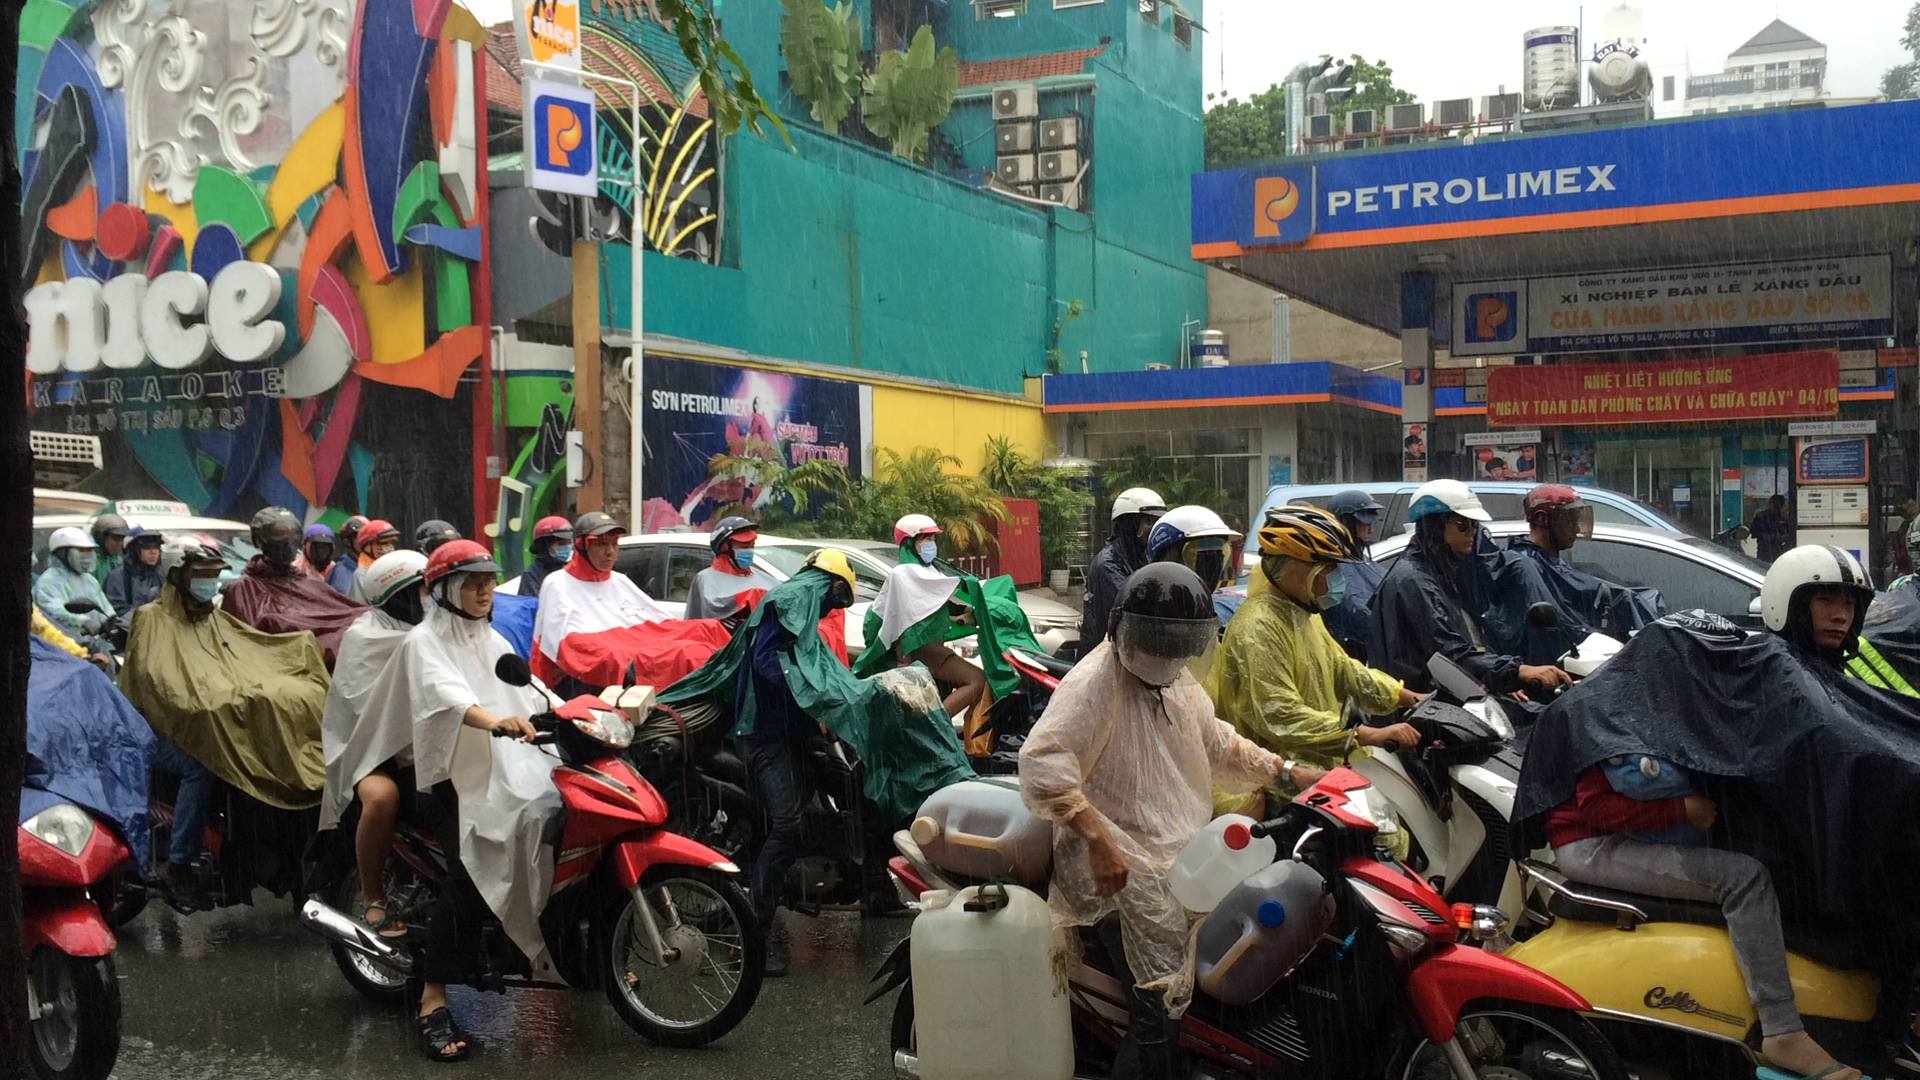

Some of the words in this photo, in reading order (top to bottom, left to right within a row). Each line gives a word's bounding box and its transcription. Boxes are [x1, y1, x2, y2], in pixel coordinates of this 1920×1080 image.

[1327, 164, 1617, 216] PETROLIMEX
[1606, 277, 1617, 286] TY
[1587, 286, 1658, 302] NGHIỆP
[24, 260, 285, 374] nice
[34, 367, 282, 408] KARAOKE
[1583, 371, 1622, 392] NHIỆT
[1625, 370, 1653, 391] LIỆT
[681, 393, 749, 417] PETROLIMEX
[1534, 396, 1567, 416] TOÀN
[1571, 396, 1597, 414] DÂN
[1601, 394, 1643, 414] PHÒNG
[1647, 391, 1682, 412] CHÁY
[1687, 391, 1705, 410] VÀ
[1710, 389, 1746, 409] CHỮA
[1798, 387, 1839, 406] 04/10
[134, 503, 172, 512] VINASUN
[1297, 984, 1339, 1001] HONDA
